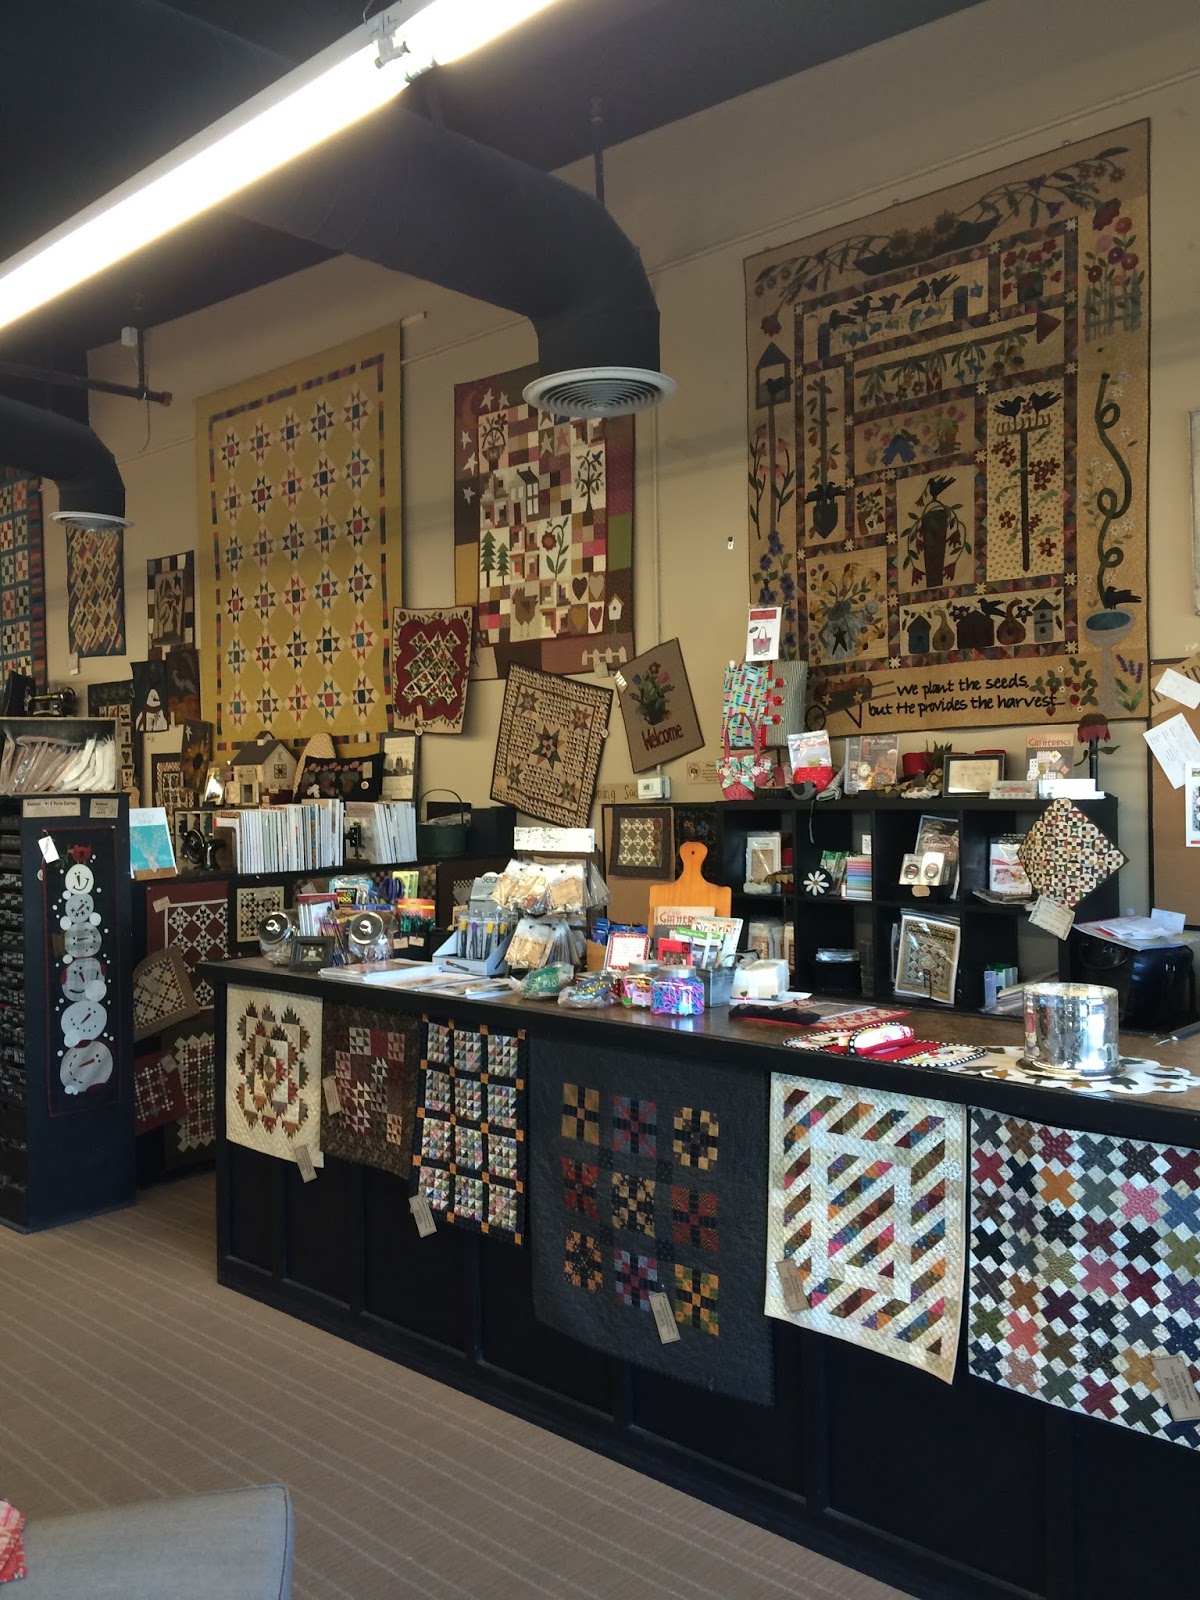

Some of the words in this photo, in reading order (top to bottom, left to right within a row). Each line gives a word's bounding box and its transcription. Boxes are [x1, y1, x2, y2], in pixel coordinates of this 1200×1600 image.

[922, 679, 954, 700] plant
[958, 677, 981, 692] the
[985, 673, 1029, 690] seeds,
[868, 702, 893, 716] but
[896, 701, 916, 714] He
[918, 697, 966, 717] provides
[971, 696, 994, 710] the
[642, 724, 684, 751] Welcome
[624, 784, 638, 800] Soo
[481, 875, 498, 884] sea
[660, 912, 693, 926] GATHER
